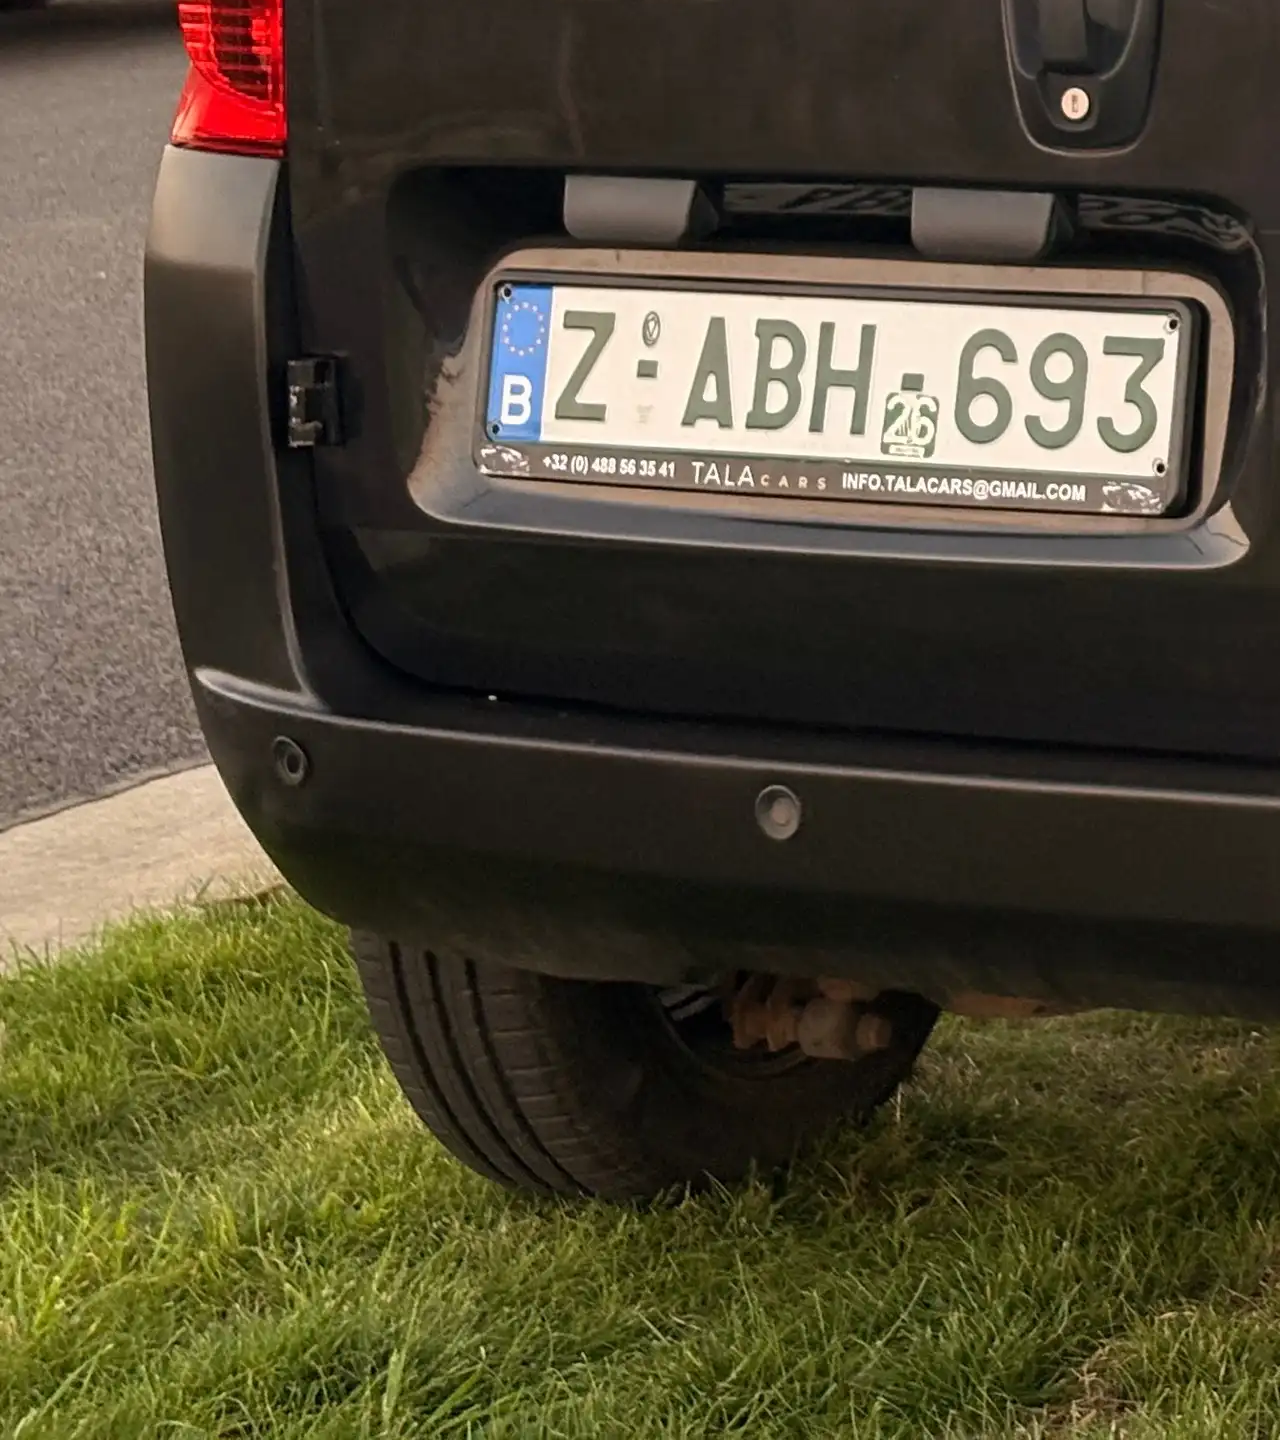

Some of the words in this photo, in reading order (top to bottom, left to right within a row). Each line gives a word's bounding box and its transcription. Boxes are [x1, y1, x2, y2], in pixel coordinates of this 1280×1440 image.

[500, 374, 532, 425] B
[882, 395, 938, 446] 26
[543, 453, 568, 471] +32
[571, 455, 589, 475] (0)
[591, 457, 616, 474] 488
[620, 458, 636, 475] 56
[639, 460, 656, 477] 35
[659, 461, 675, 478] 41
[692, 461, 755, 488] TALA
[760, 474, 827, 490] CARS
[842, 471, 1086, 502] INFO.TALACARS@GMAIL.COM
